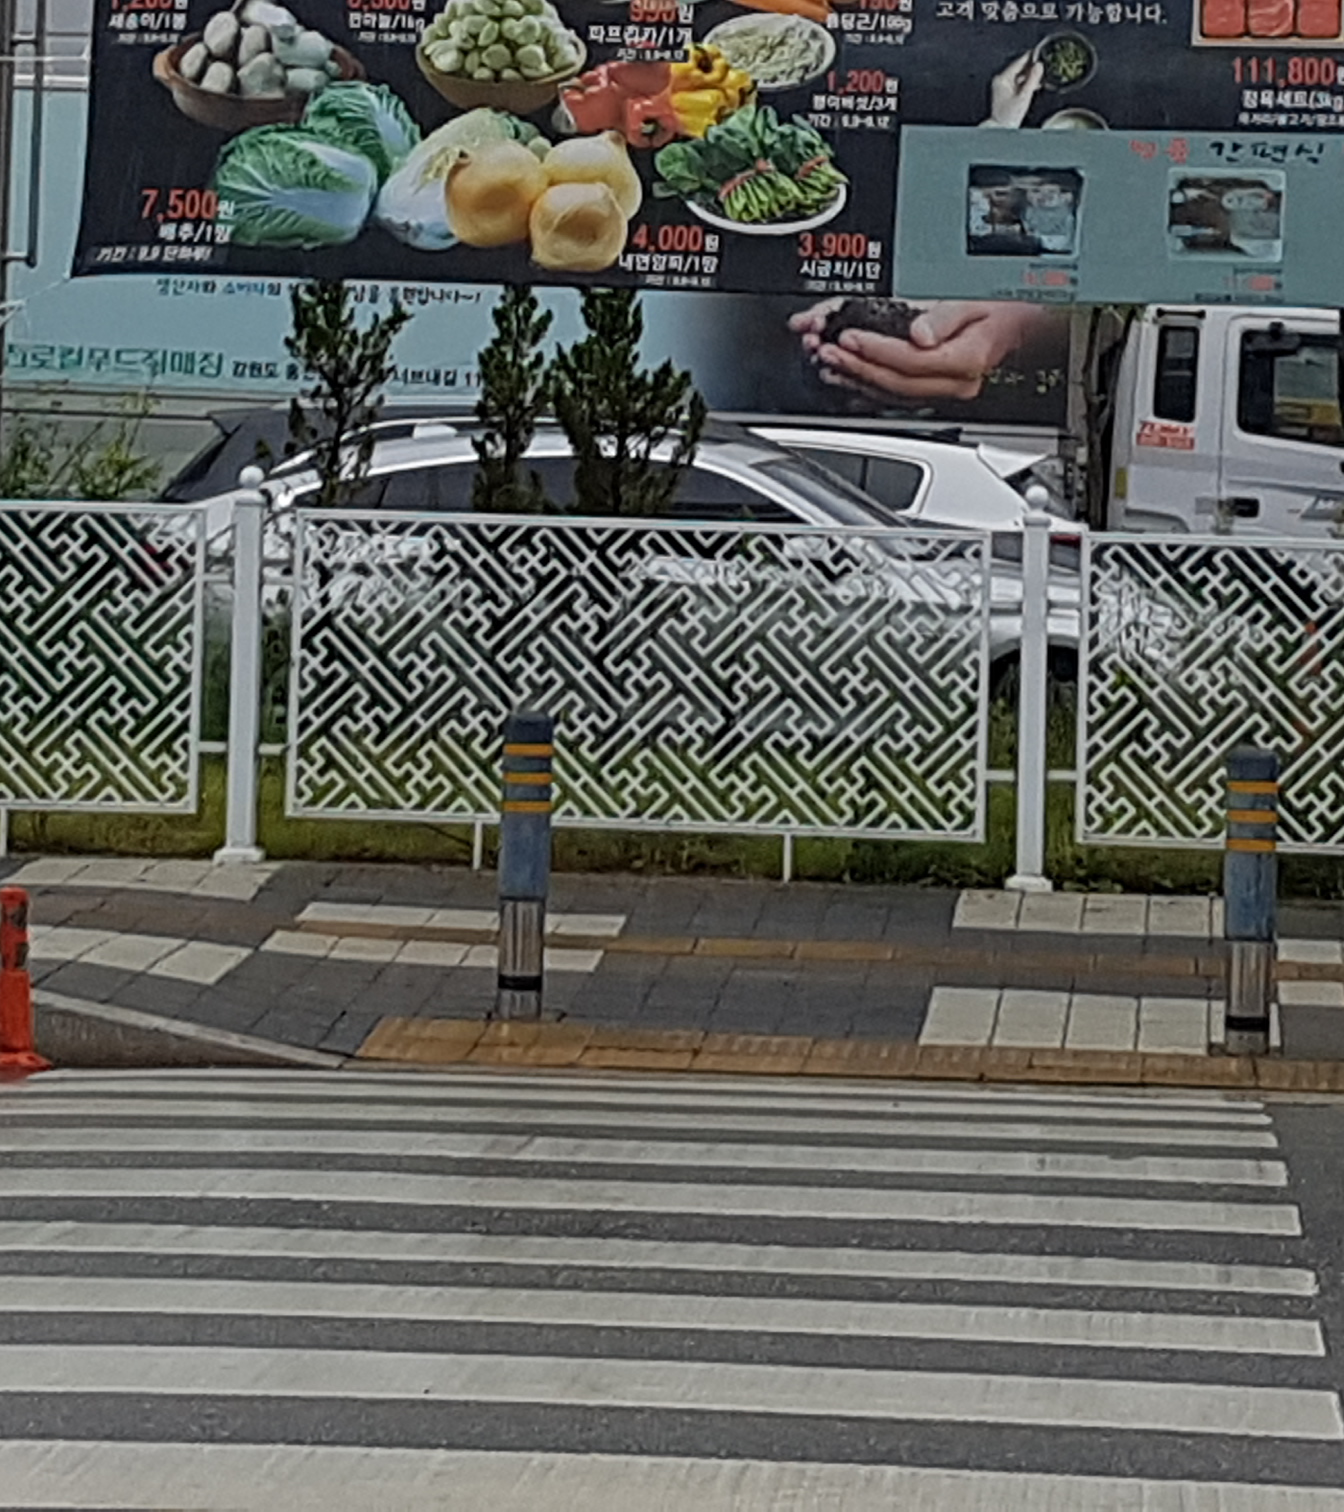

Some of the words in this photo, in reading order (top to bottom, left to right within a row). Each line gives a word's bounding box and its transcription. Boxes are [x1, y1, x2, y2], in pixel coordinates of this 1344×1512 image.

[827, 70, 899, 95] 1,200원
[1209, 140, 1325, 165] 간편식
[140, 188, 235, 223] 7,500원
[633, 223, 720, 253] 4,000원
[797, 232, 882, 259] 3,900원
